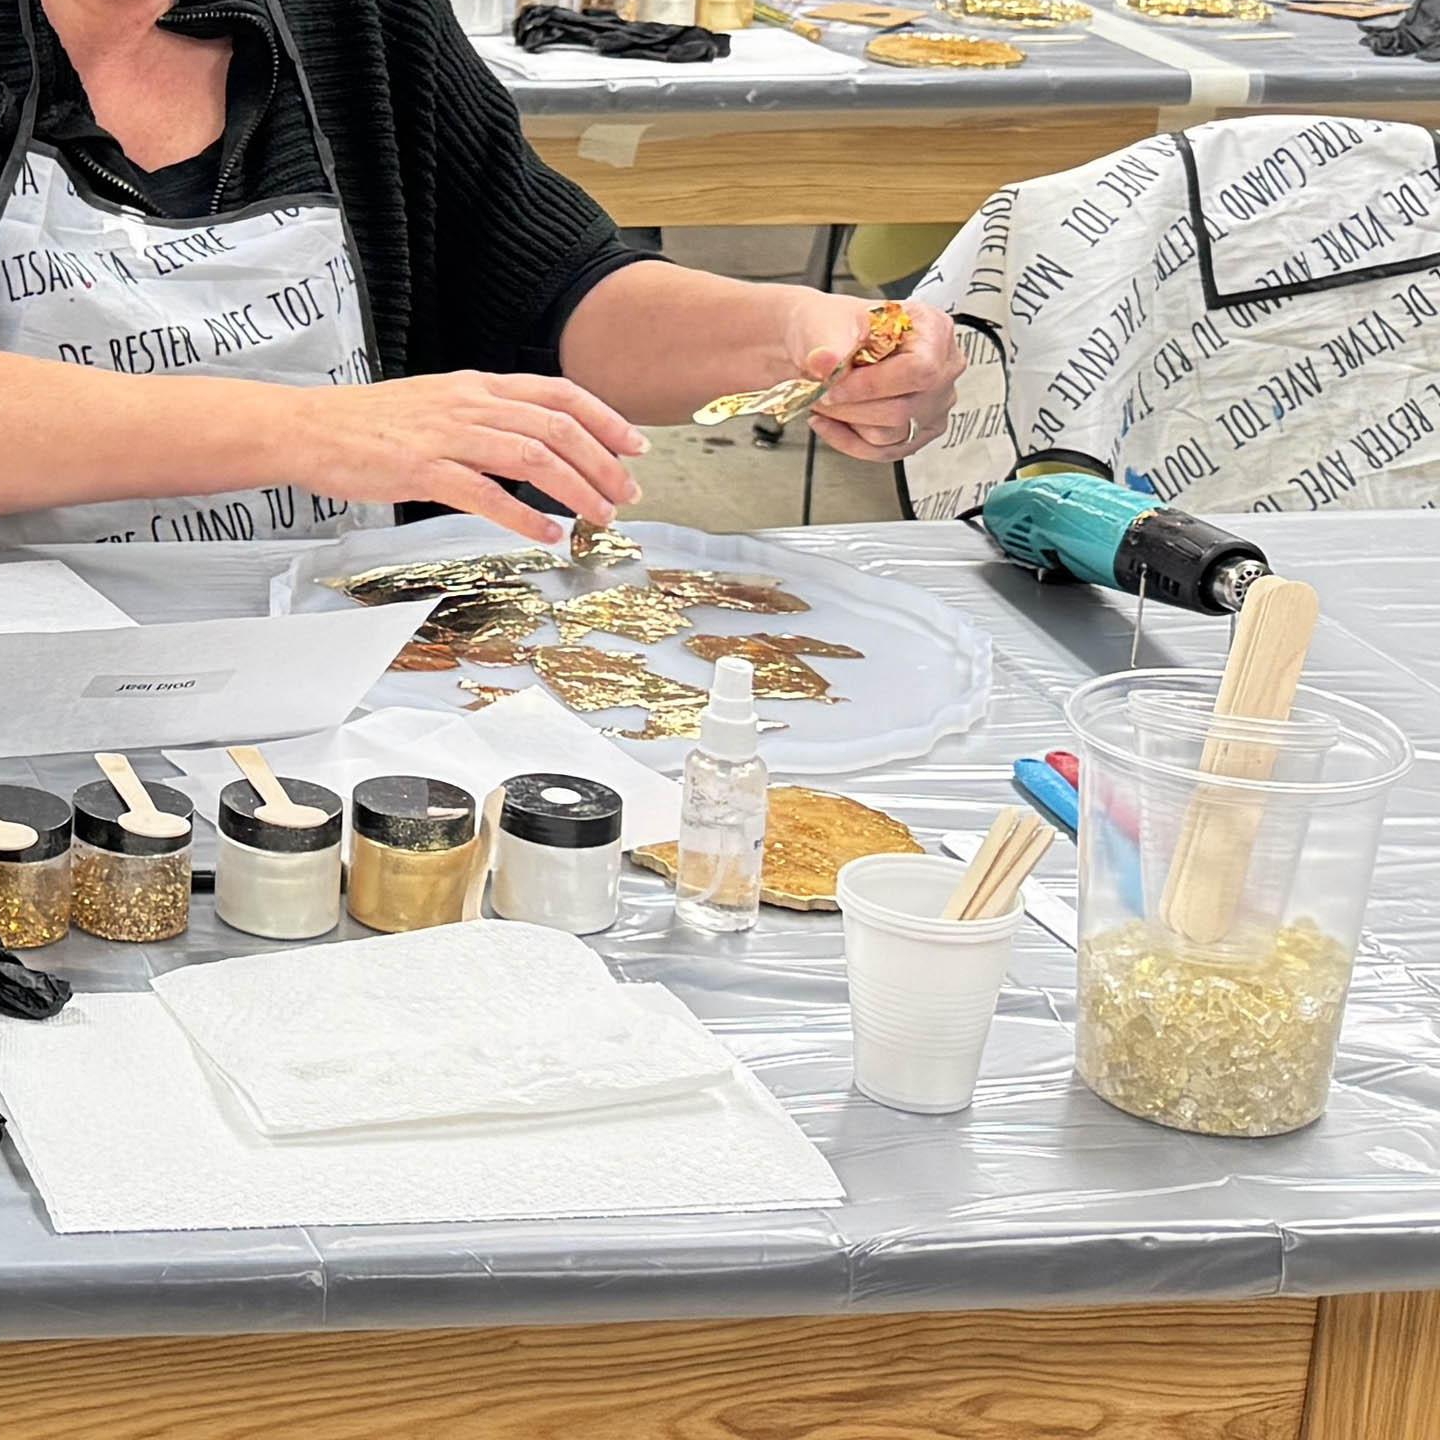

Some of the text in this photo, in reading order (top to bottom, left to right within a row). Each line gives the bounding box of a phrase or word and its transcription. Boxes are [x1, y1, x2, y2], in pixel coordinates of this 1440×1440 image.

[1297, 121, 1364, 167] RIRE
[11, 159, 40, 196] A
[1096, 154, 1160, 209] AVEC
[977, 187, 1020, 257] TOUTE
[1061, 198, 1120, 248] TOI
[1383, 183, 1430, 226] DE
[1311, 204, 1396, 272] VIVRE
[1010, 253, 1074, 326] MAIS
[1110, 277, 1148, 344] J'AI
[1391, 283, 1439, 328] DE
[110, 325, 201, 376] RESTER
[203, 304, 274, 358] AVEC
[267, 278, 325, 332] TOI
[1191, 314, 1230, 360] TU
[1321, 310, 1406, 378] VIVRE
[1047, 326, 1121, 411] ENVIE
[1153, 338, 1194, 390] RIS
[1257, 356, 1323, 420] AVEC
[1216, 398, 1271, 450] TOI
[1288, 398, 1435, 512] RESTER AVEC
[262, 485, 295, 529] TU
[156, 679, 197, 691] gold
